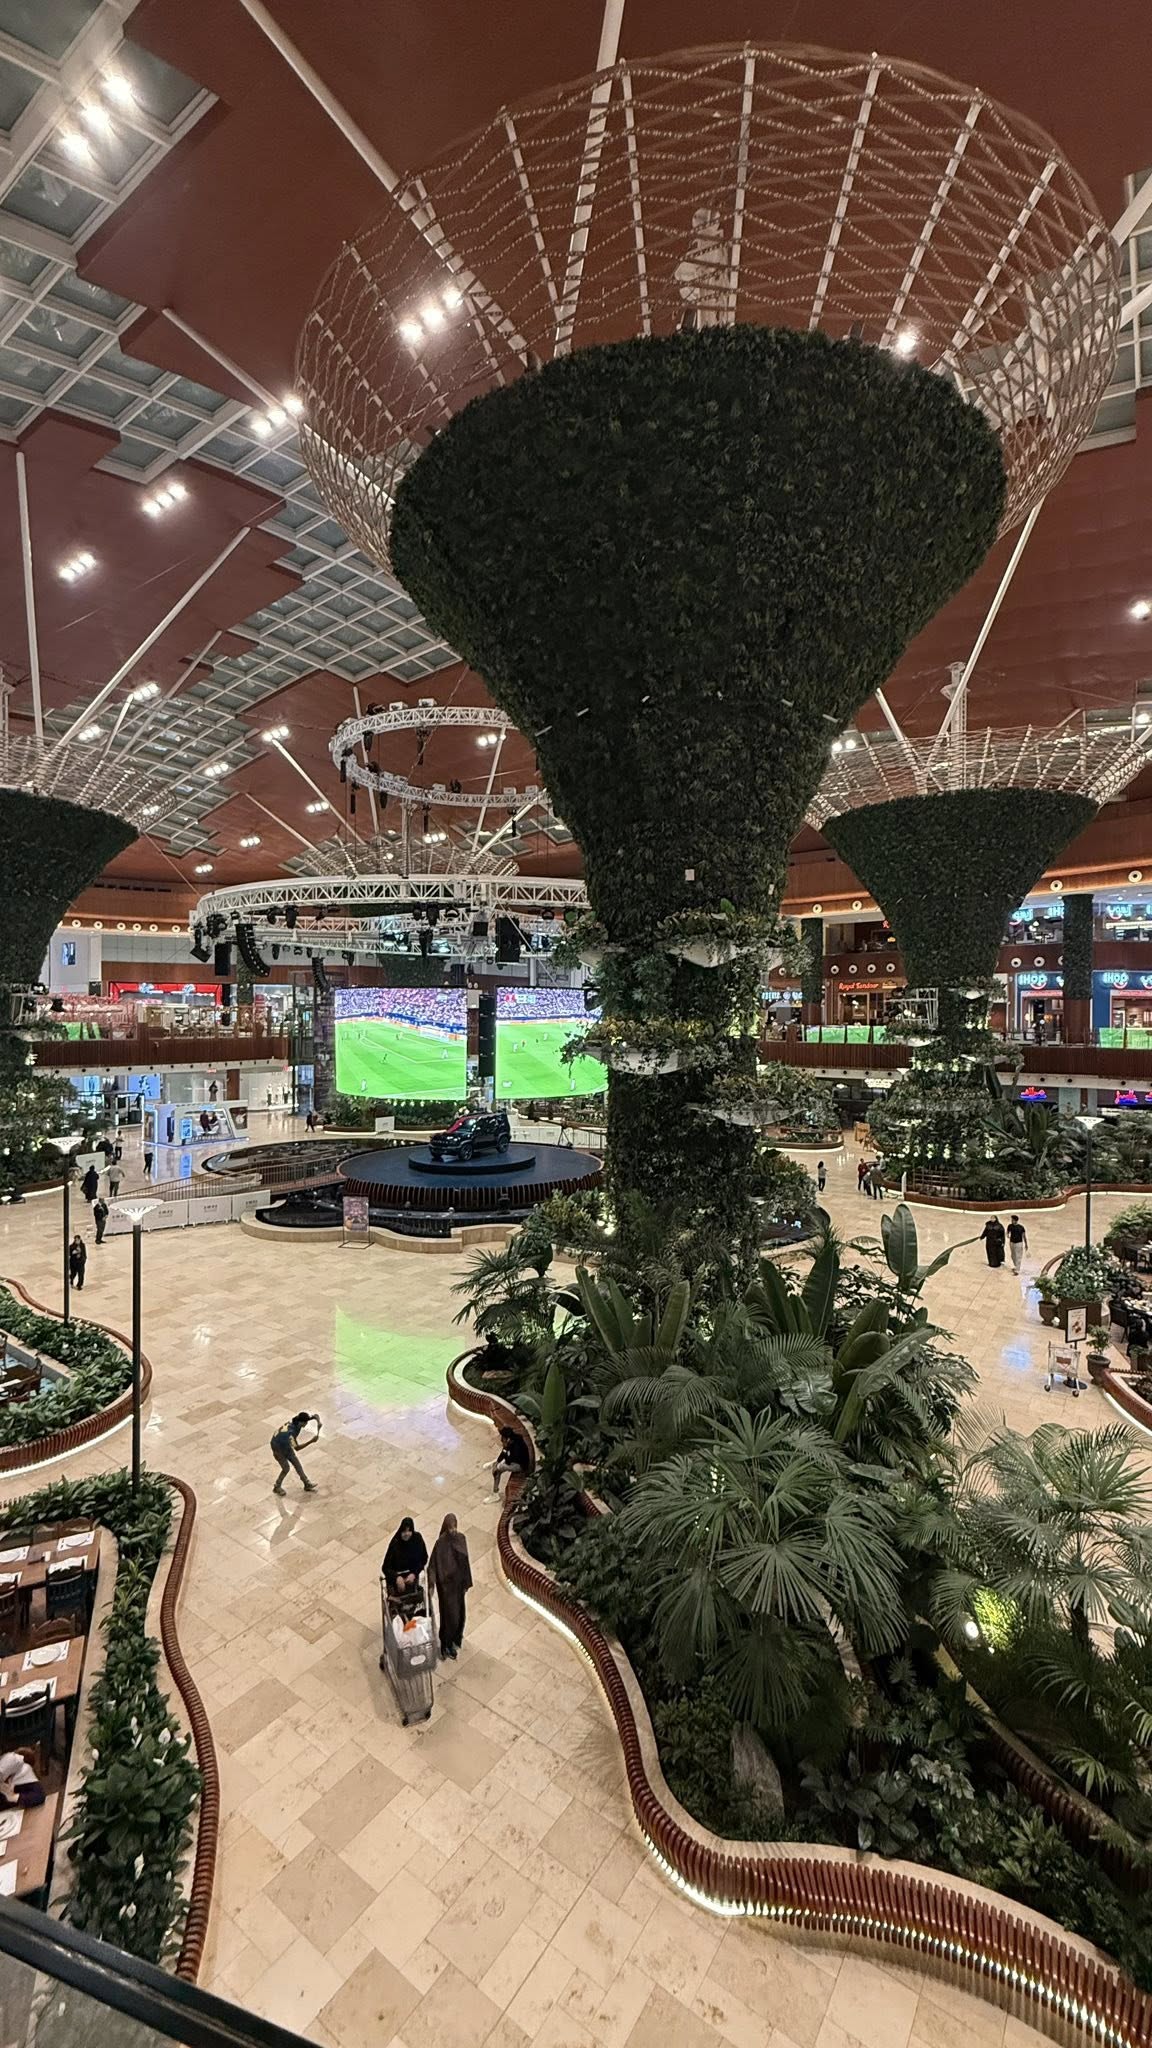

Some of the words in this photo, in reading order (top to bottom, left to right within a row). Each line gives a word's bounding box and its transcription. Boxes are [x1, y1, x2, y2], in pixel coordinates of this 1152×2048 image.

[1018, 973, 1048, 987] IHOP
[1103, 972, 1130, 986] IHOP
[839, 982, 855, 991] Royal
